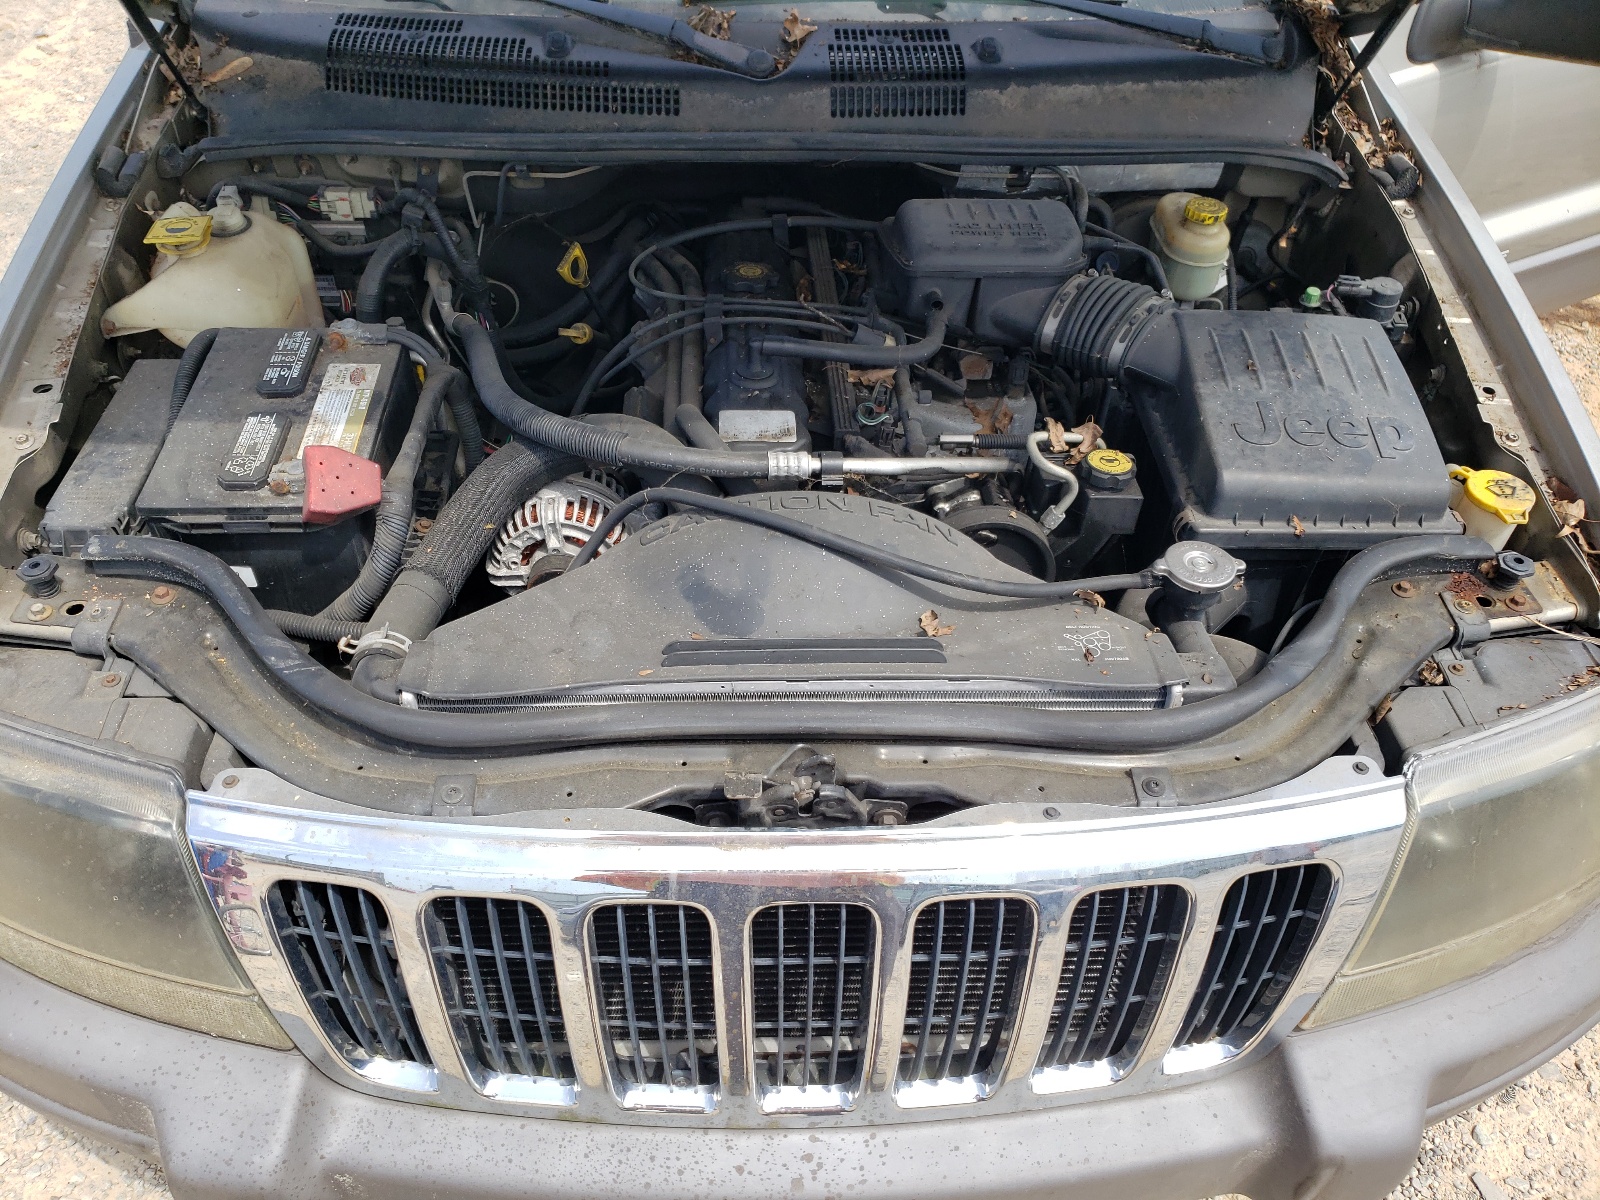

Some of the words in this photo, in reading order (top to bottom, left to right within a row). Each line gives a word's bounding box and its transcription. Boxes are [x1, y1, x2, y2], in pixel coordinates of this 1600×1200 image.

[1233, 400, 1415, 460] Jeep
[640, 494, 854, 546] CATION
[868, 500, 959, 547] FAN
